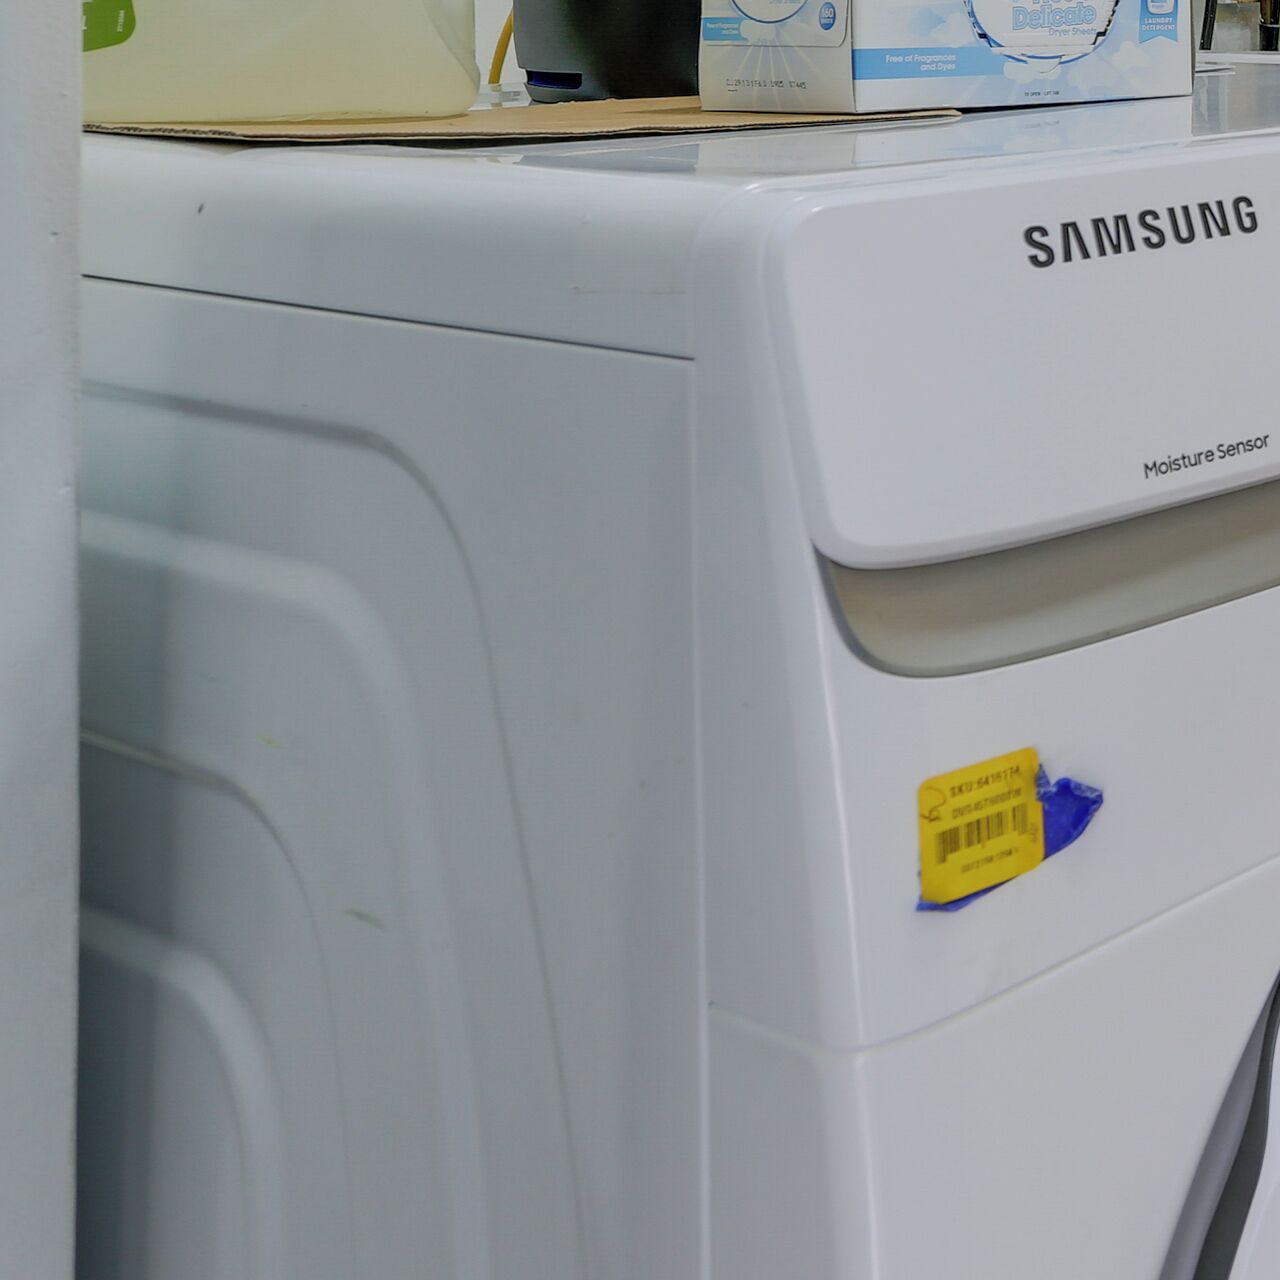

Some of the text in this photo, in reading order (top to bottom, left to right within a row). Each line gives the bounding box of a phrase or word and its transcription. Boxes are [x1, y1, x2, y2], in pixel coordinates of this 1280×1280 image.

[1012, 1, 1097, 31] Delicate
[1049, 26, 1097, 37] Dryer Sheets
[885, 54, 957, 64] Free of Fragrances
[920, 62, 956, 71] and Dyes
[1023, 195, 1259, 270] SAMSUNG
[1143, 432, 1270, 480] Moisture Sensor
